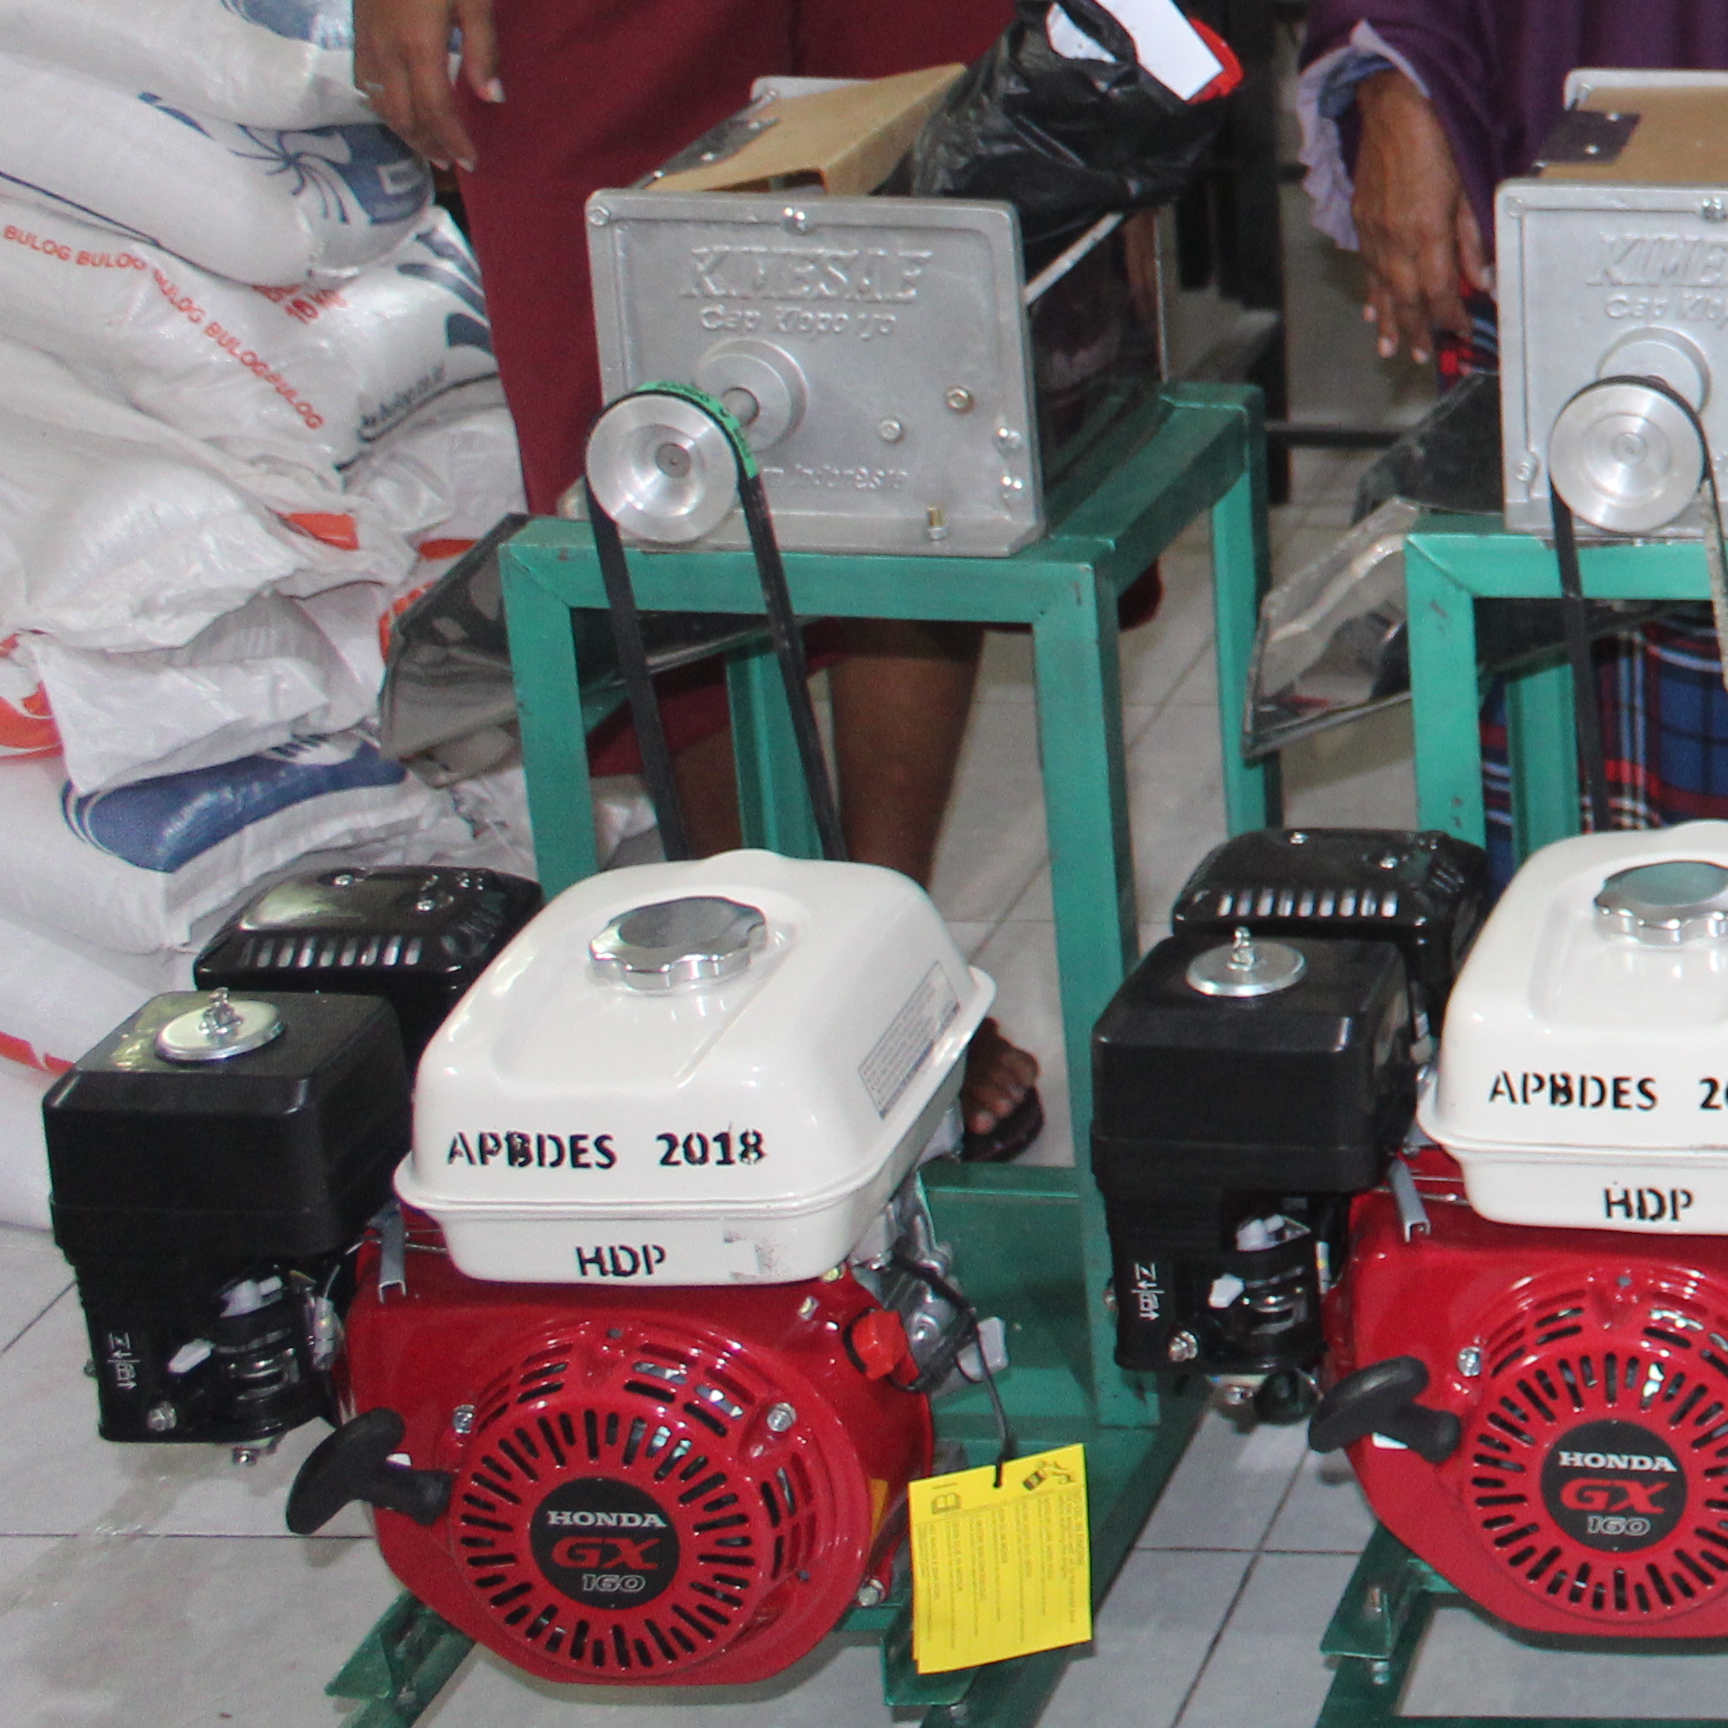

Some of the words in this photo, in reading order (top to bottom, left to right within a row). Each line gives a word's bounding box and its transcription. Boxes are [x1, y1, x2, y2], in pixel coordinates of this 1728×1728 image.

[4, 225, 72, 261] BULOG
[204, 321, 271, 377] BULOG
[1490, 1073, 1658, 1112] APBDES
[448, 1131, 617, 1170] APBDES
[656, 1130, 766, 1167] 2018
[1604, 1188, 1694, 1222] HDP
[575, 1243, 667, 1278] HDP
[1558, 1450, 1678, 1474] HONDA
[1560, 1478, 1668, 1515] GX
[547, 1510, 666, 1529] HONDA
[1584, 1515, 1653, 1538] 160
[553, 1538, 660, 1570] GX
[580, 1574, 646, 1593] 160
